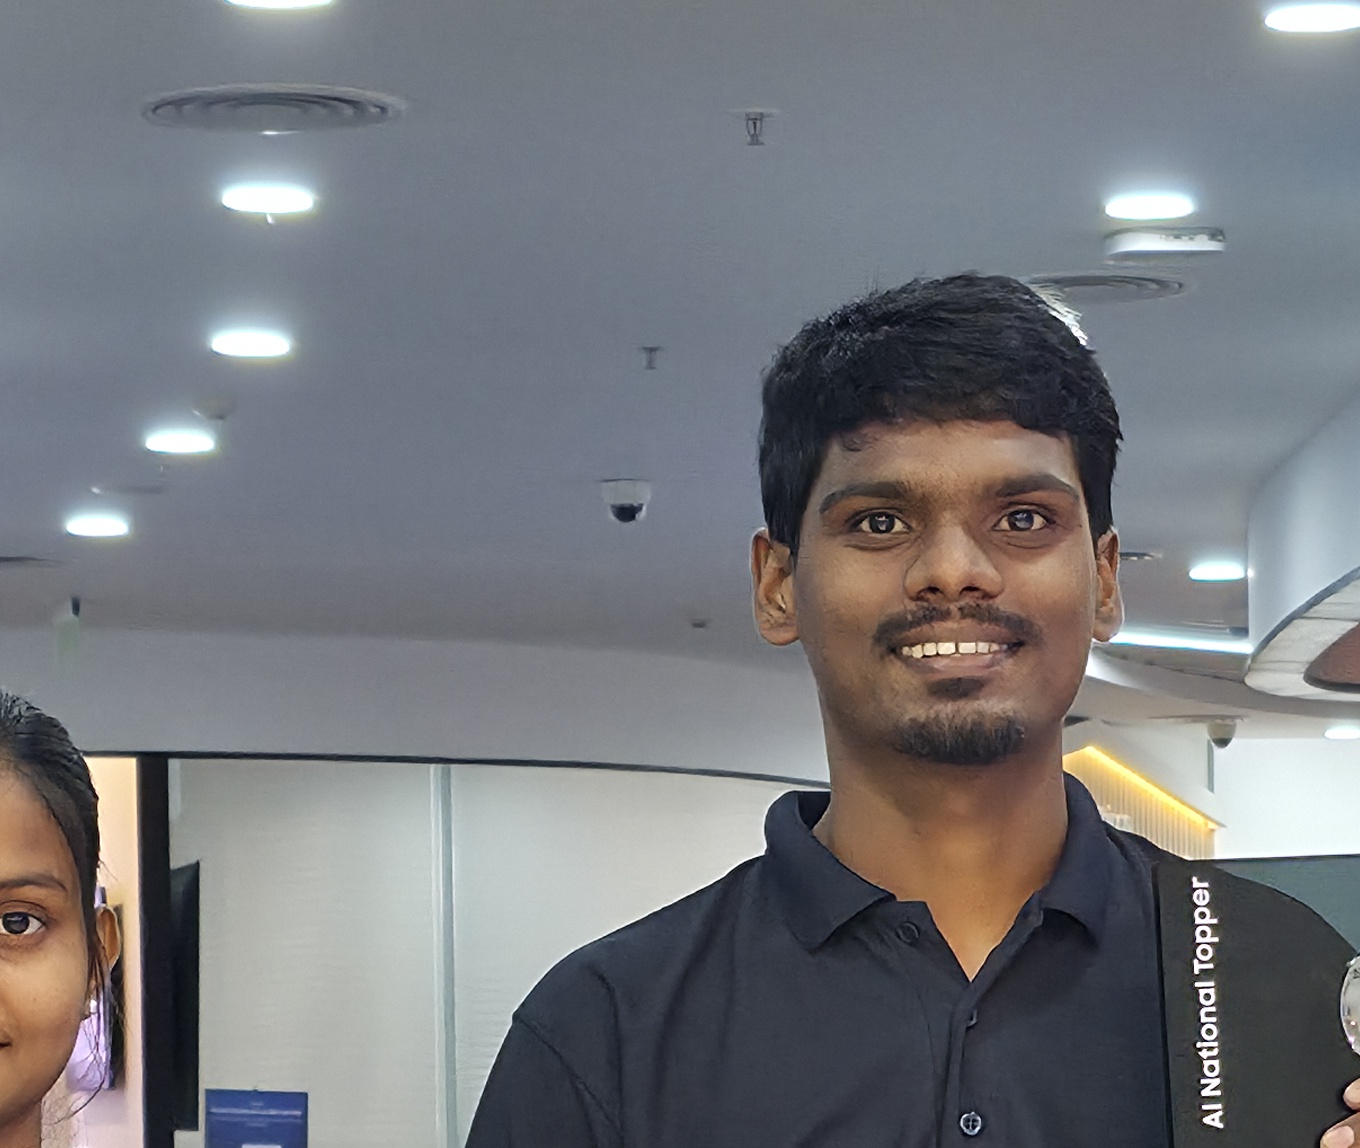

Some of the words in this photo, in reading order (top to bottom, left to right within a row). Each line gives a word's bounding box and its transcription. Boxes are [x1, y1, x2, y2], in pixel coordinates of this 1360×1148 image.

[1191, 876, 1220, 975] Topper
[1194, 978, 1223, 1097] National
[1202, 1104, 1224, 1129] AI
